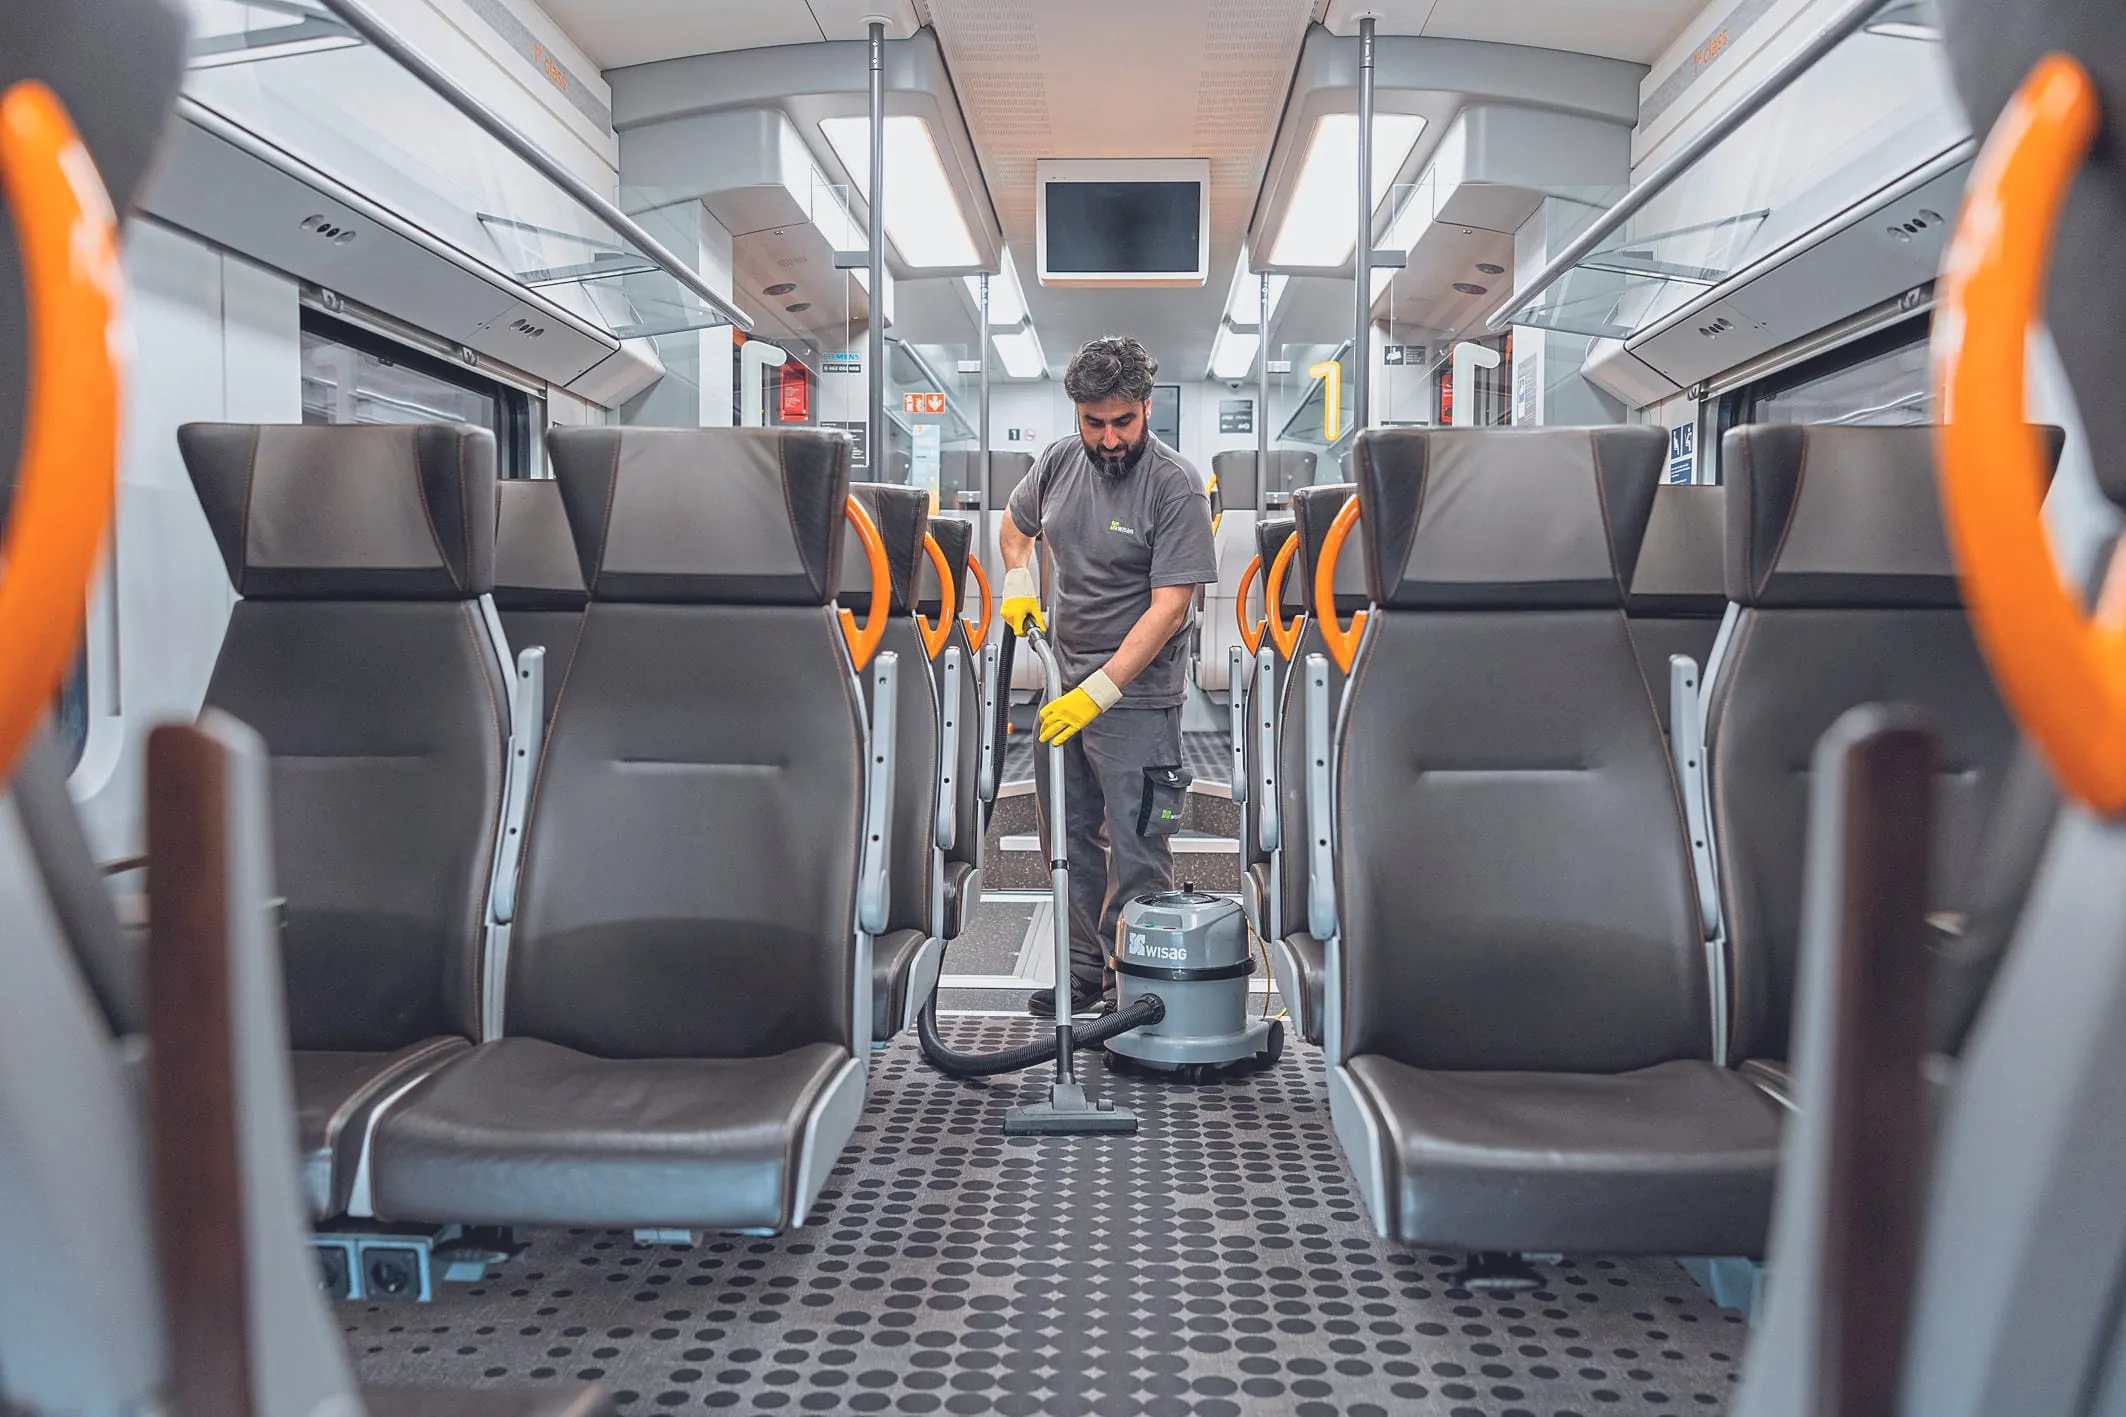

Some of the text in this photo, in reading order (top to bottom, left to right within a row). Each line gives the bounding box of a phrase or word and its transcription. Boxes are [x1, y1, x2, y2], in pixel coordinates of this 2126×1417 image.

[1703, 28, 1729, 65] class
[544, 55, 568, 91] class
[1308, 360, 1341, 441] 1
